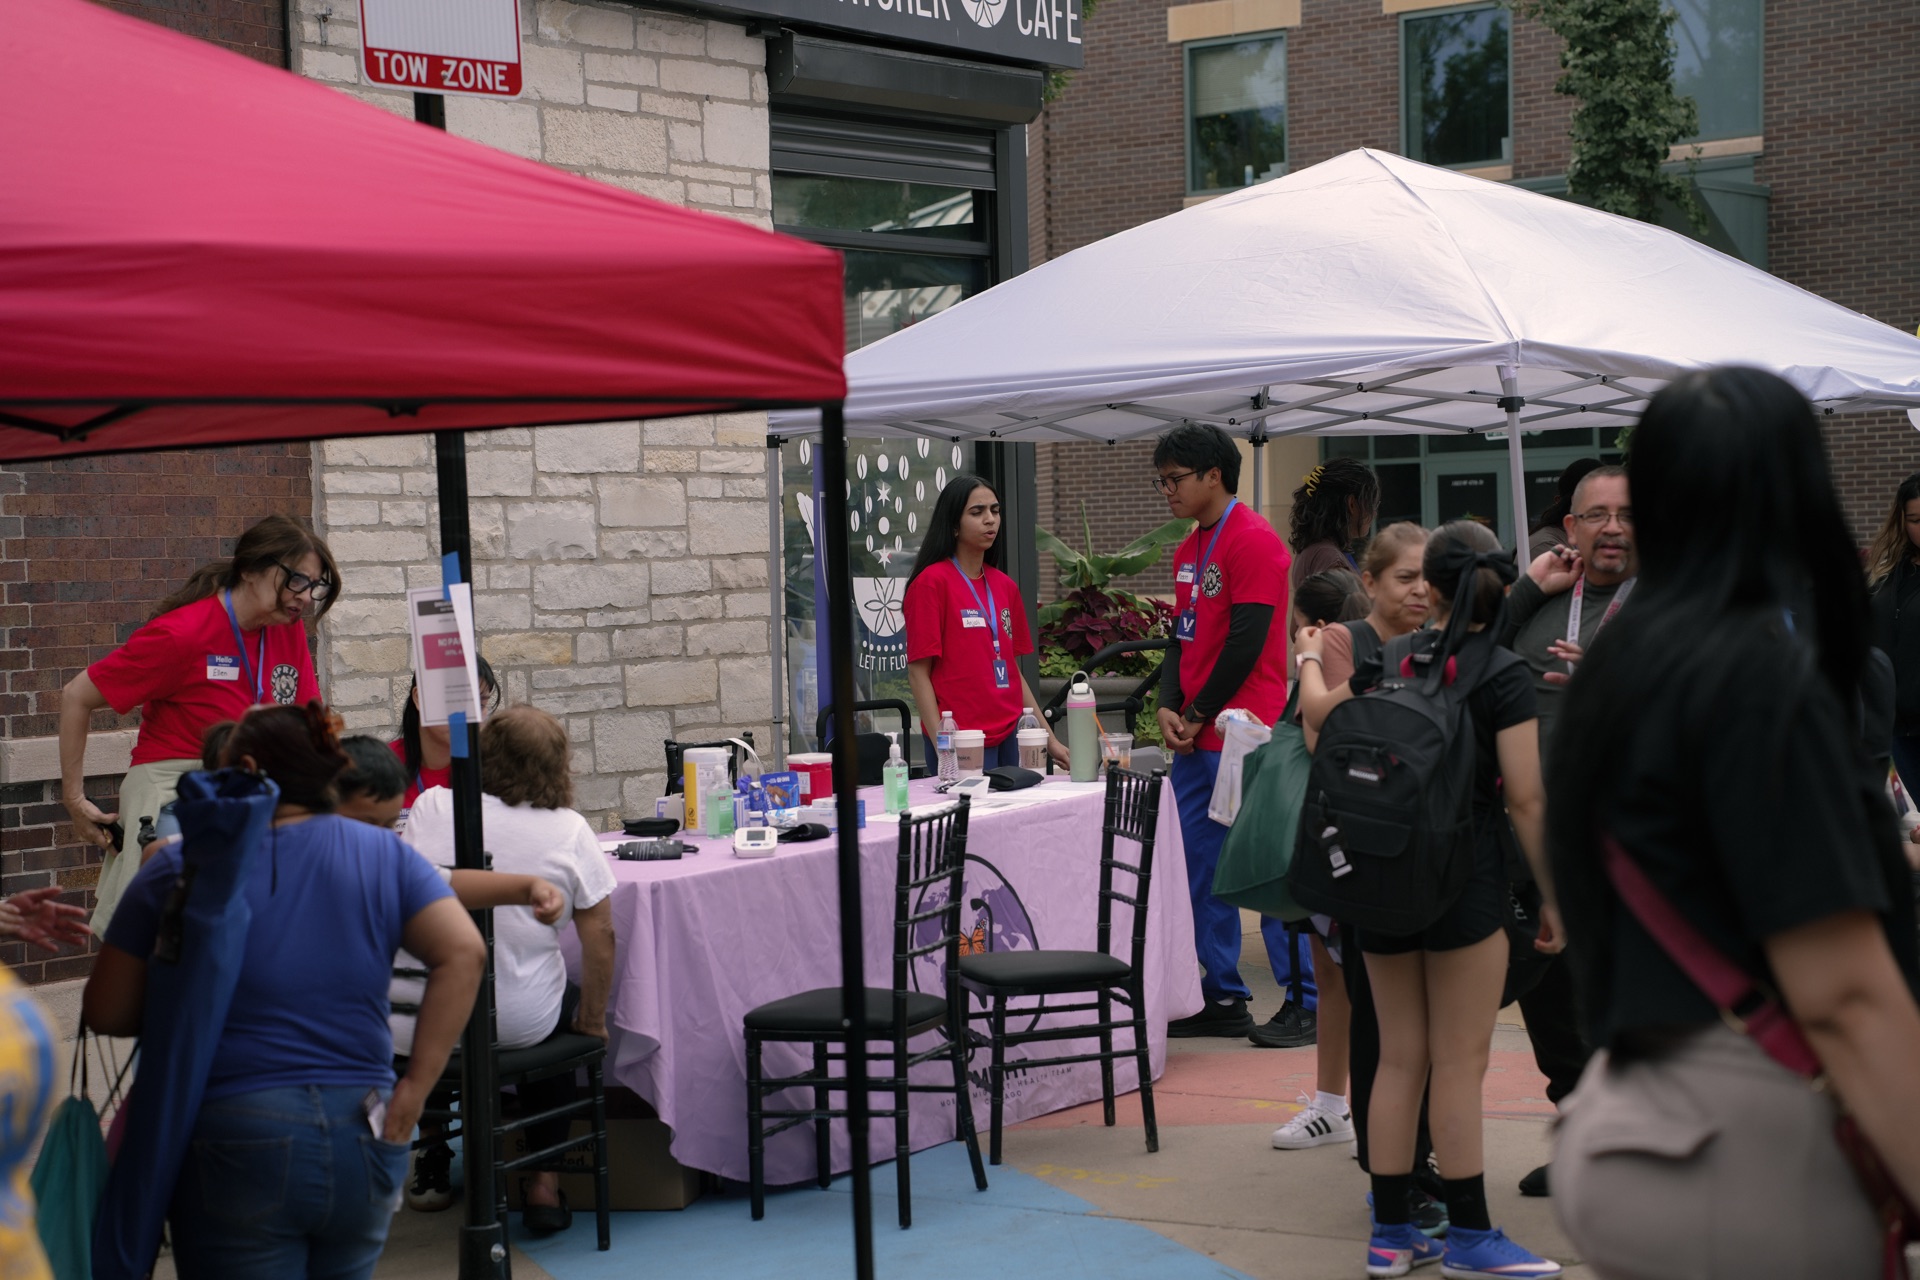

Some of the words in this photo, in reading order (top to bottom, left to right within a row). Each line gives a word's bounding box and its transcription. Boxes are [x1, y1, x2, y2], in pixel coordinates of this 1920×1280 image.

[374, 51, 428, 84] TOW
[441, 59, 510, 92] ZONE
[859, 653, 876, 670] LET
[878, 656, 887, 671] IT
[890, 654, 908, 671] FLO
[1017, 1072, 1048, 1087] HEALTH
[1051, 1066, 1072, 1077] TEAM
